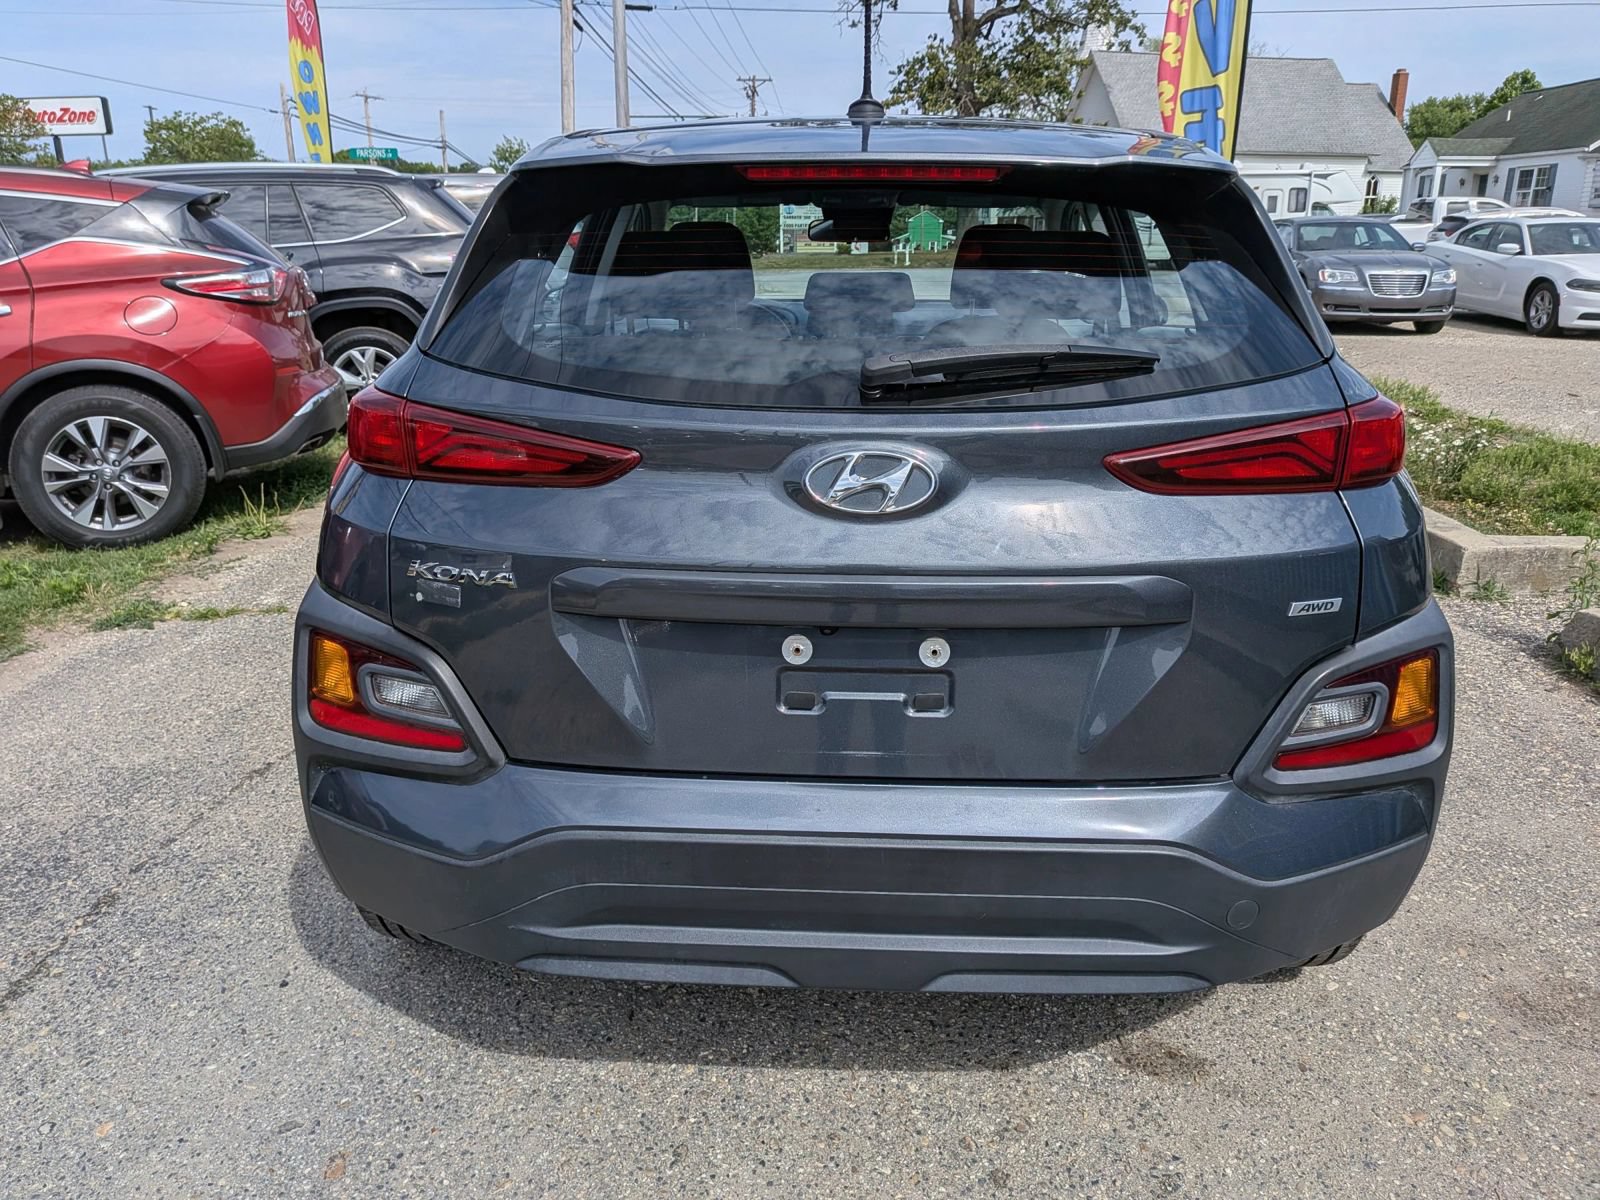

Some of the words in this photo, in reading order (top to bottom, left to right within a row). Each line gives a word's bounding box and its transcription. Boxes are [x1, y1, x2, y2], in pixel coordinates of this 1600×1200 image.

[24, 107, 97, 124] utoZone
[356, 149, 386, 159] PARSONS
[406, 559, 518, 589] KONA
[1297, 601, 1335, 613] AWD
